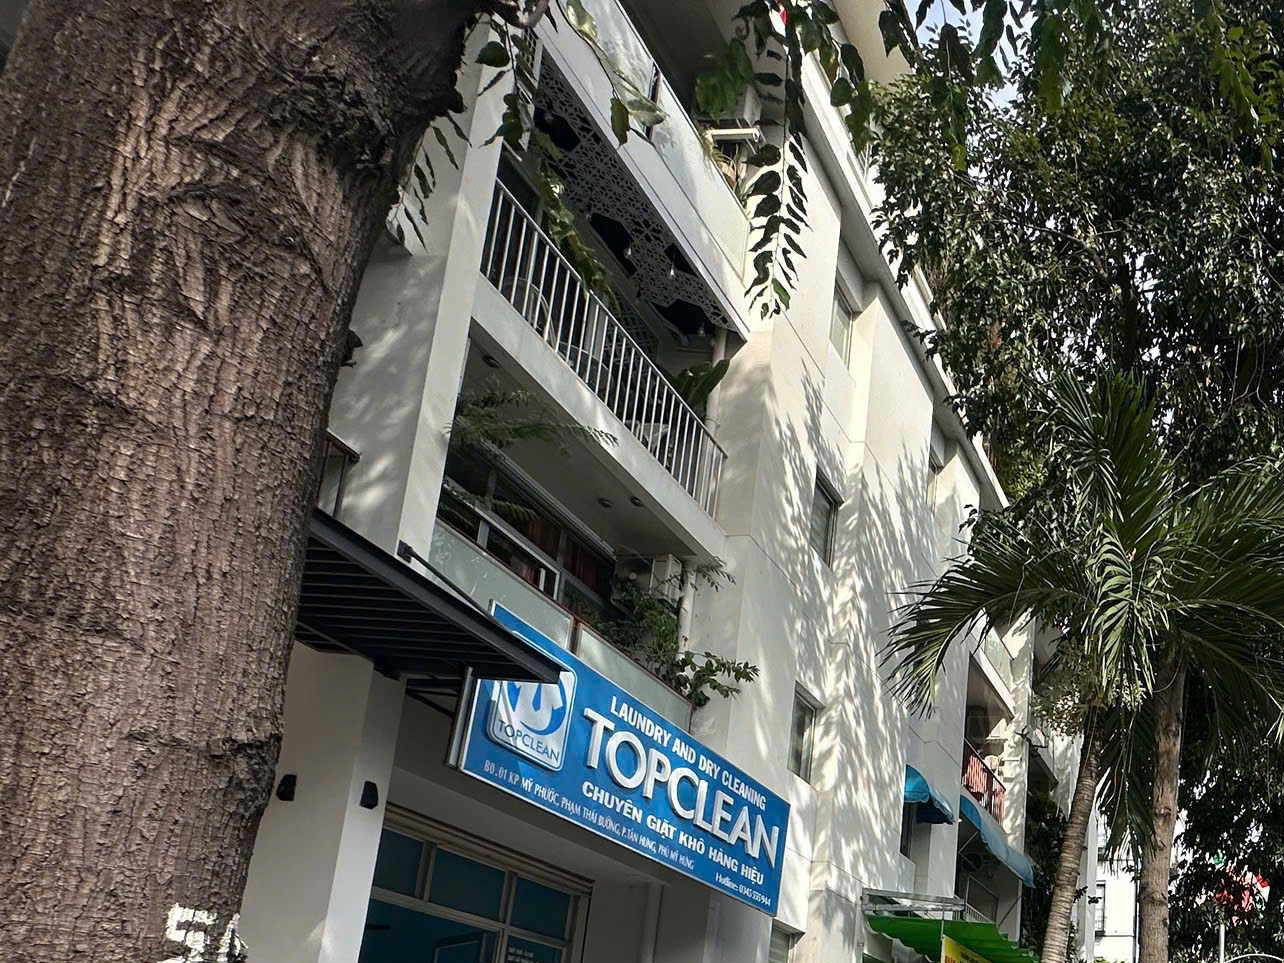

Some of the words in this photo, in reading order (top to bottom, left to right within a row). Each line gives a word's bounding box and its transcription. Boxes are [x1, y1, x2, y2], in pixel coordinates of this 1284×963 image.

[496, 720, 560, 761] TOPCLEAN
[508, 773, 520, 785] KP
[583, 707, 780, 871] TOPCLEAN
[611, 696, 672, 748] LAUNDRY
[672, 737, 696, 764] AND
[698, 756, 721, 780] DRY
[721, 770, 767, 811] CLEANING
[582, 781, 643, 824] CHUYÊN
[646, 815, 677, 840] GIẶT
[678, 831, 706, 855] KHÔ
[708, 846, 739, 873] HÀNG
[740, 863, 764, 885] HIỆU
